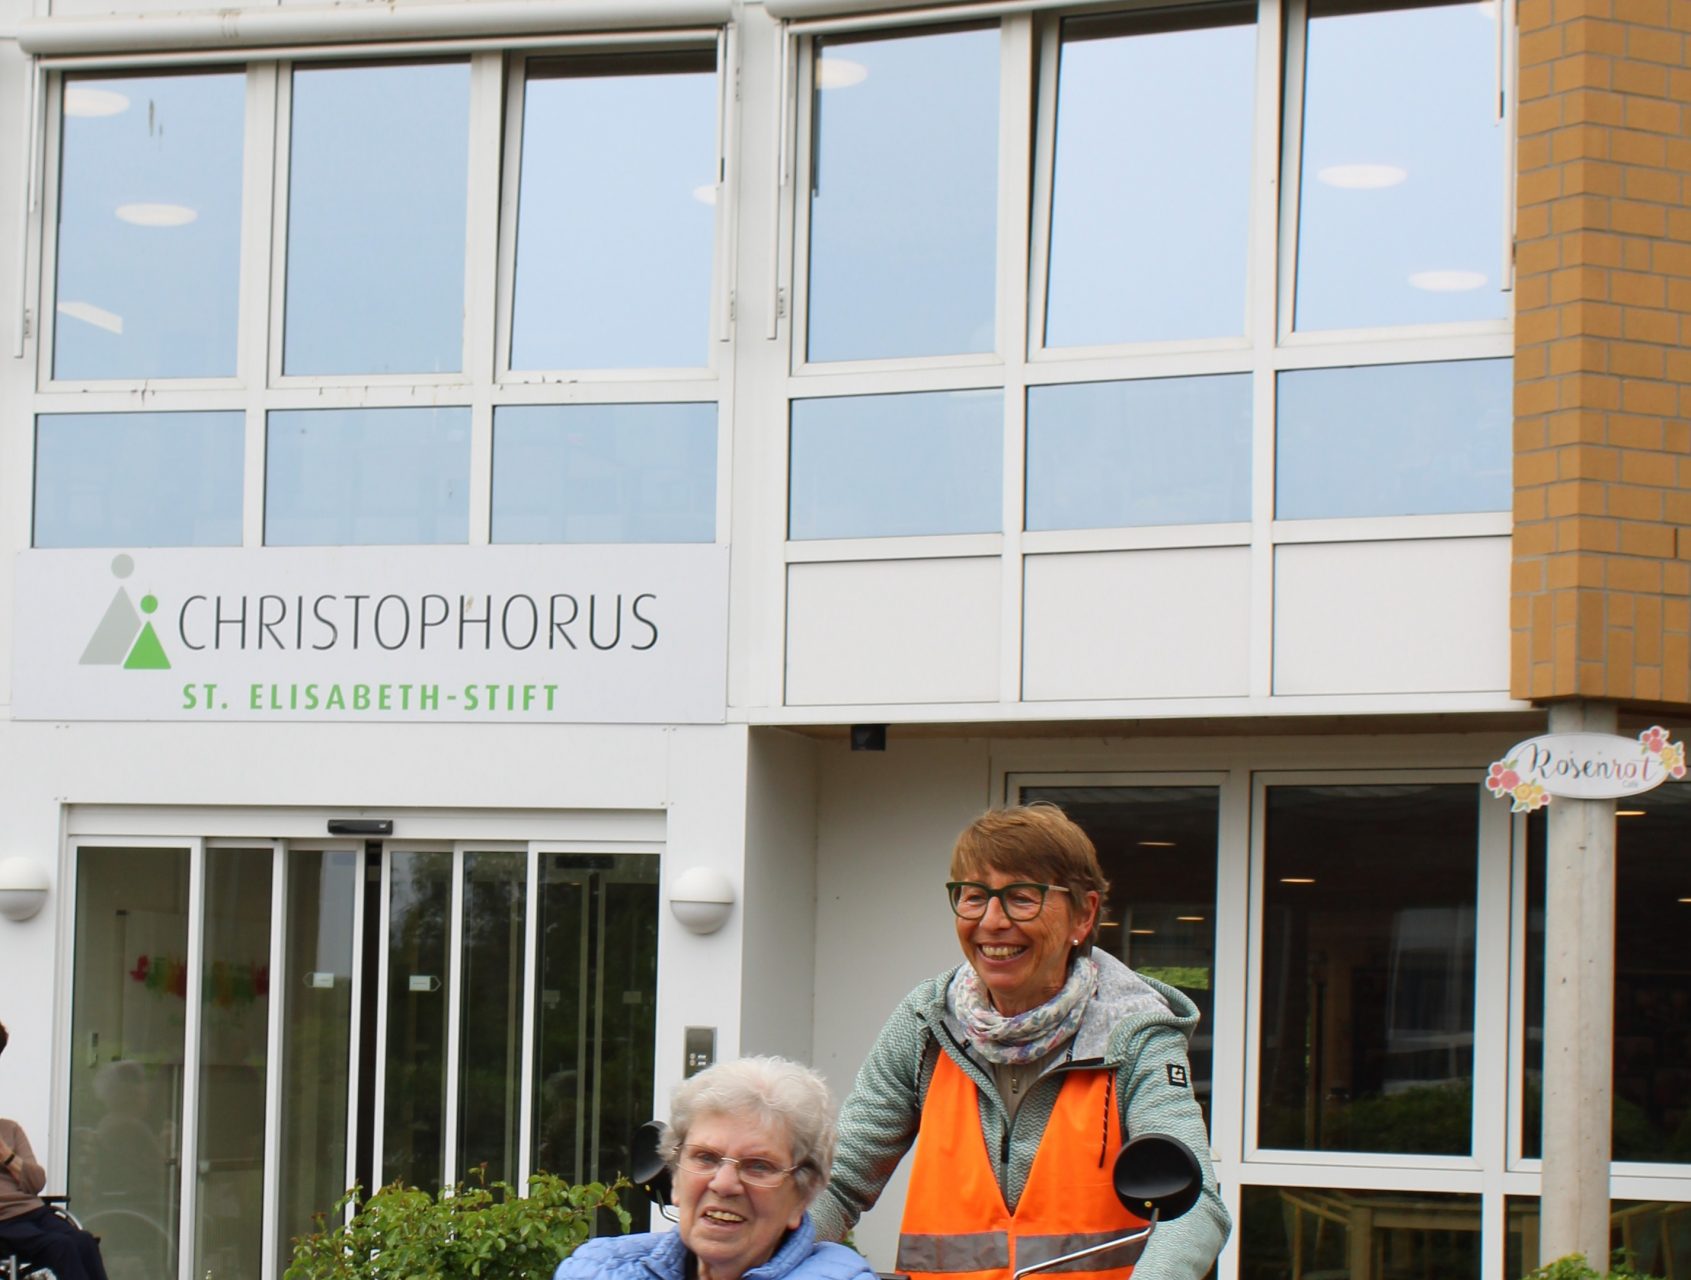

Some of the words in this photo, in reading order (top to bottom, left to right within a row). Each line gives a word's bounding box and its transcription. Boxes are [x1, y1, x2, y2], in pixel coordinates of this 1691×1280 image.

[178, 592, 659, 651] CHRISTOPHORUS
[182, 683, 229, 710] ST.
[249, 683, 559, 711] ELISABETH-STIFT
[1515, 742, 1660, 782] Rosenrot
